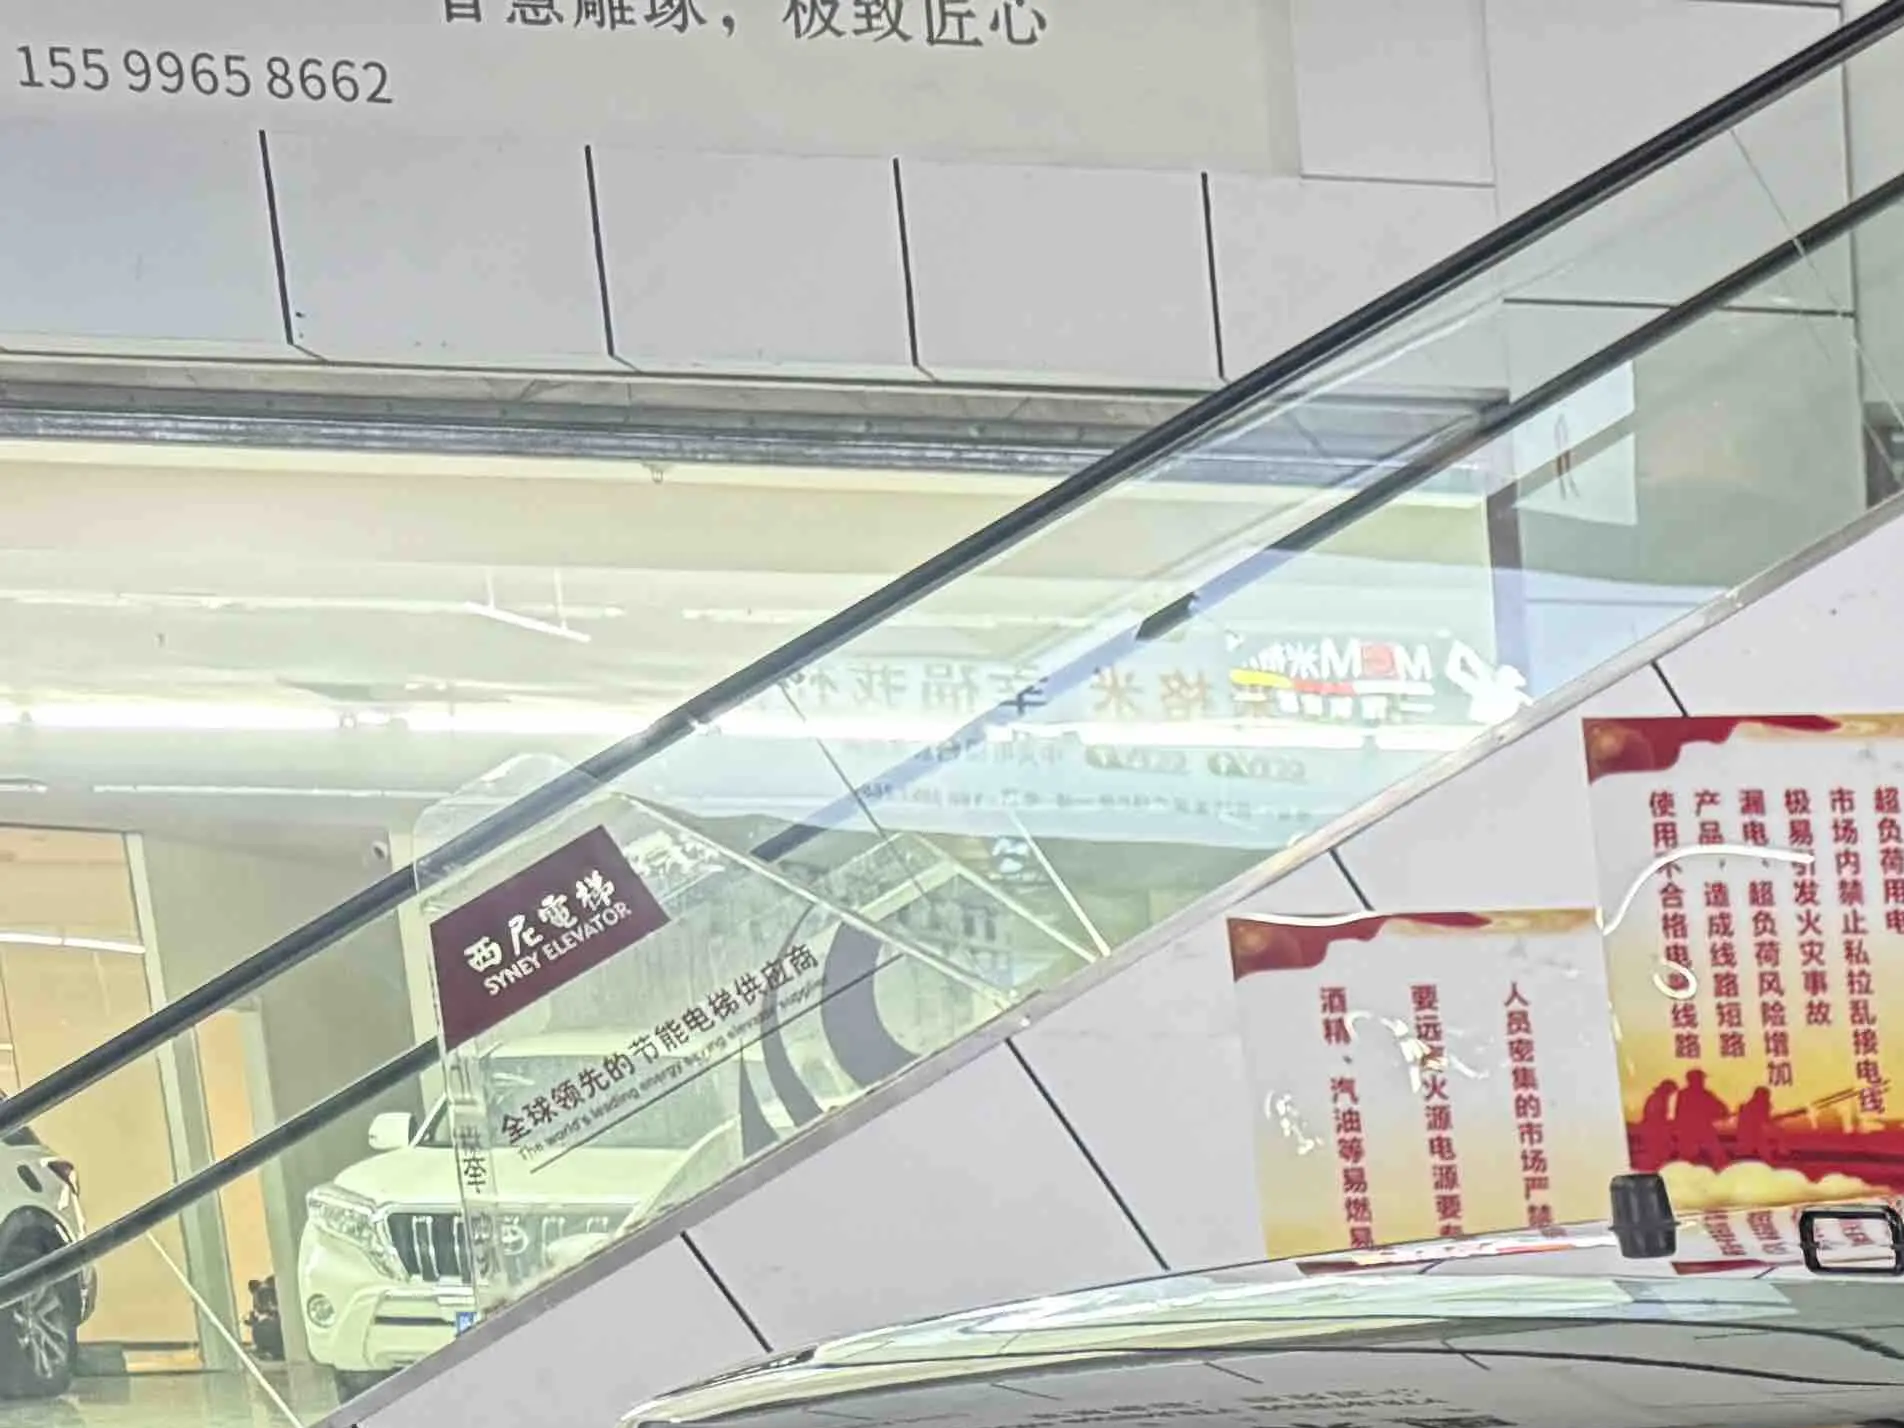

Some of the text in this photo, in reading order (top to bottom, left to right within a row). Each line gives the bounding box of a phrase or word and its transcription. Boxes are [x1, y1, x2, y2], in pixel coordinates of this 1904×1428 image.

[16, 45, 393, 104] 155 9965 8662
[543, 900, 630, 962] ELEVATOR
[500, 943, 820, 1145] 全球领先的节能电梯供应商
